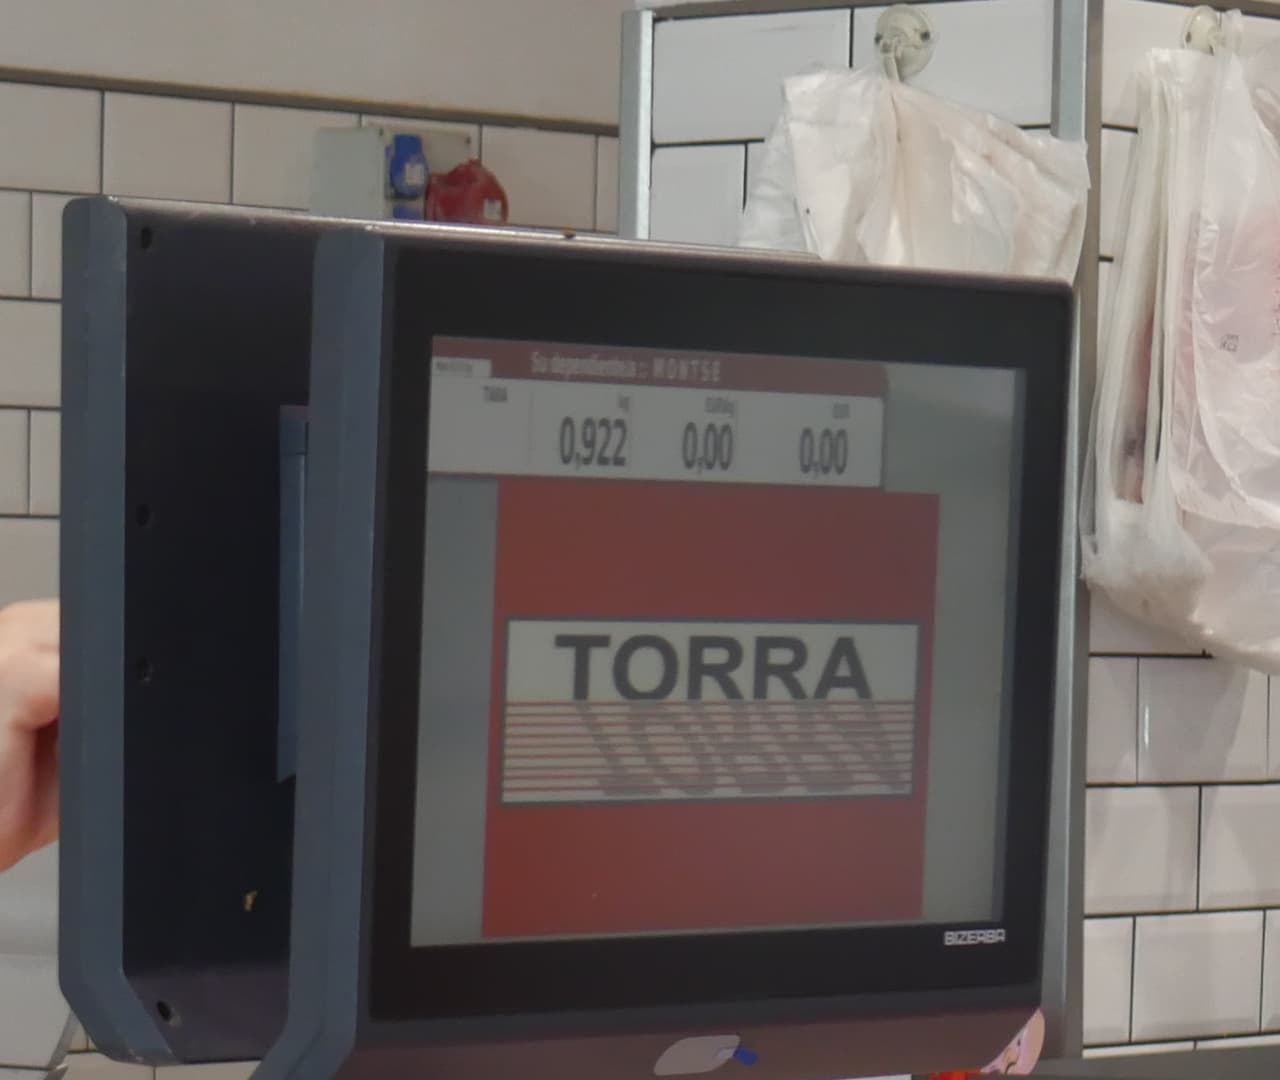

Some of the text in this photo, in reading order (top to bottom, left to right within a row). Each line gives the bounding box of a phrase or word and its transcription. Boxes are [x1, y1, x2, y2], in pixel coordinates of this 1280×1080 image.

[652, 358, 722, 383] MONTSE
[559, 416, 628, 470] 0,922
[682, 421, 734, 475] 0,00
[799, 427, 849, 479] 0,00
[554, 633, 873, 701] TORRA
[943, 928, 1006, 946] BIZERBA
